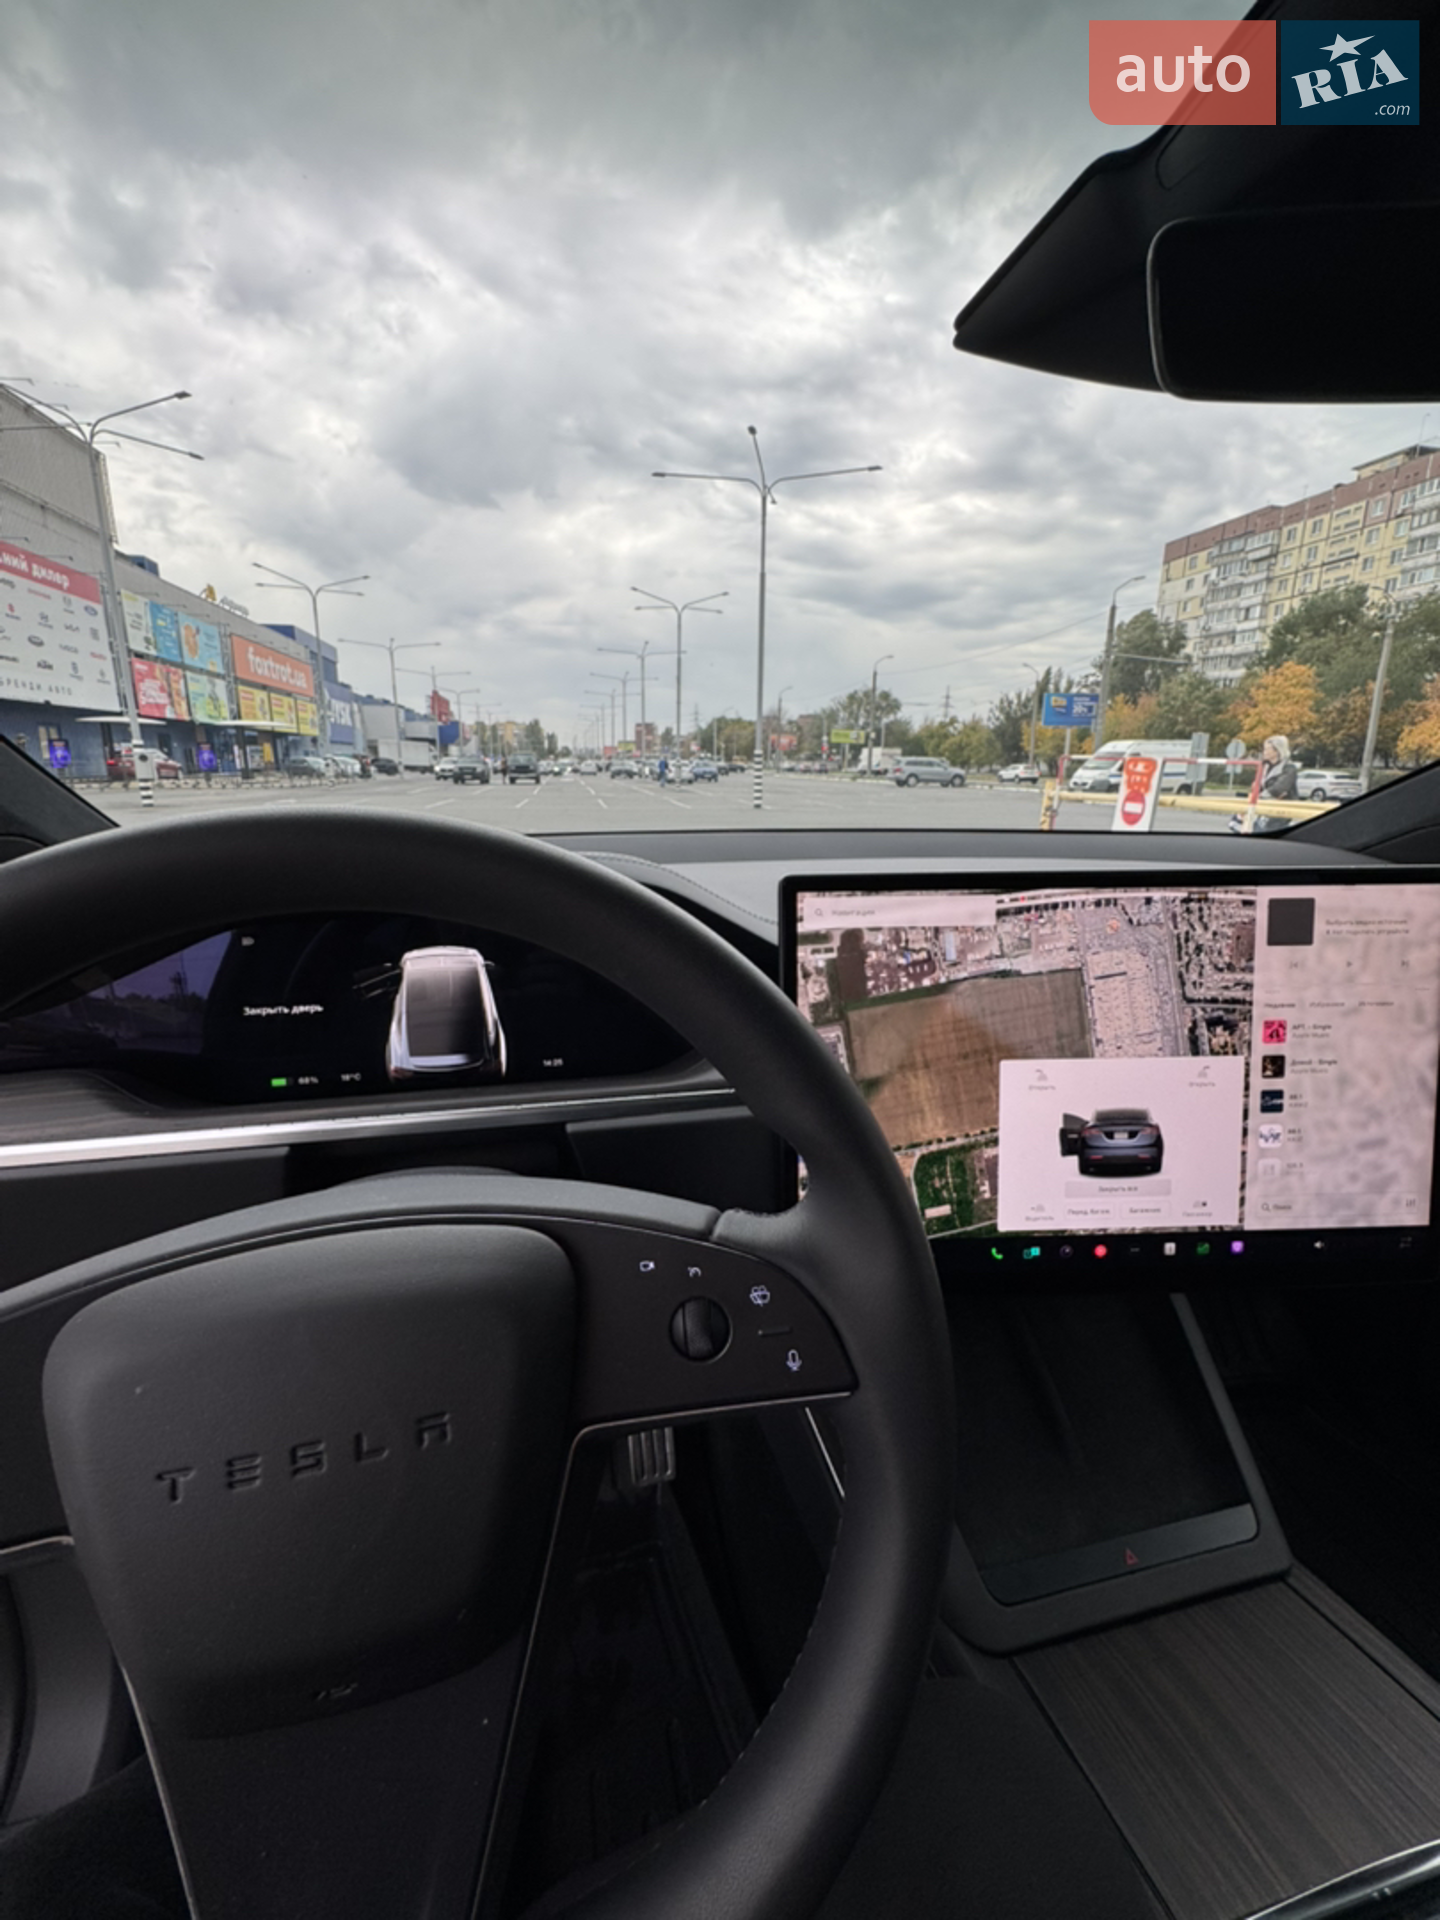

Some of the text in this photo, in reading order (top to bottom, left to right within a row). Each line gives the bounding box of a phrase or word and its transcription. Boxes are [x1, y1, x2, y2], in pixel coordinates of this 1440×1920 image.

[0, 551, 29, 573] ний
[31, 562, 70, 591] дилер
[247, 645, 309, 690] foxtrot.ua
[243, 1004, 324, 1017] Закрыть дверь
[155, 1410, 452, 1504] TESLA
